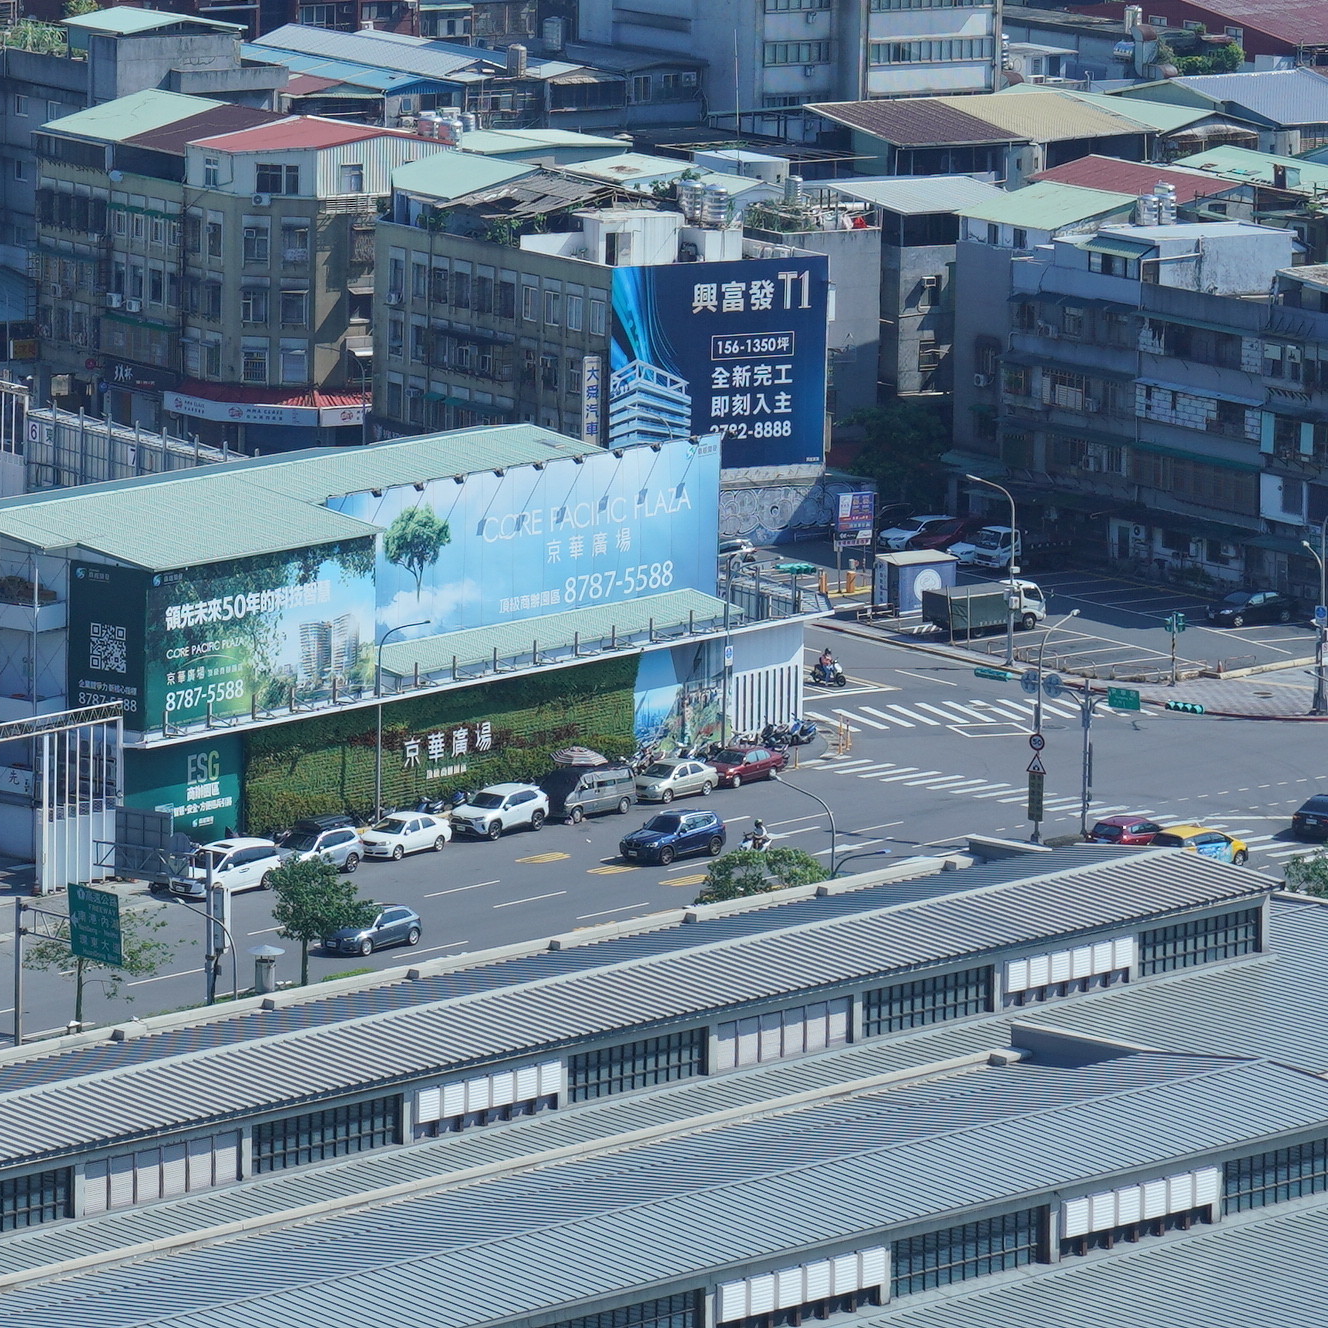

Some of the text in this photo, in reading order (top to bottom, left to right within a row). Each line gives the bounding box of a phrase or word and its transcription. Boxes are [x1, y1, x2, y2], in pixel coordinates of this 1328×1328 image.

[692, 270, 812, 314] 興富發 T1
[717, 336, 790, 355] 156-1350坪
[711, 363, 793, 389] 全新完工
[585, 366, 600, 437] 大舜汽車
[710, 391, 793, 418] 即刻入主
[30, 423, 38, 440] 6
[483, 486, 692, 543] CORE PACIFIC PLAZA
[546, 527, 632, 564] 京華廣場
[499, 560, 675, 614] 頂級商辦園區 8787-5588
[165, 579, 332, 632] 領先未來50年的科技智慧
[166, 646, 190, 660] CORE
[191, 640, 221, 656] PACIFIC
[166, 665, 205, 686] 京華廣場
[166, 678, 244, 711] 8787-5588
[404, 721, 492, 768] 京華廣場
[1032, 737, 1042, 747] 50
[187, 749, 220, 786] ESG
